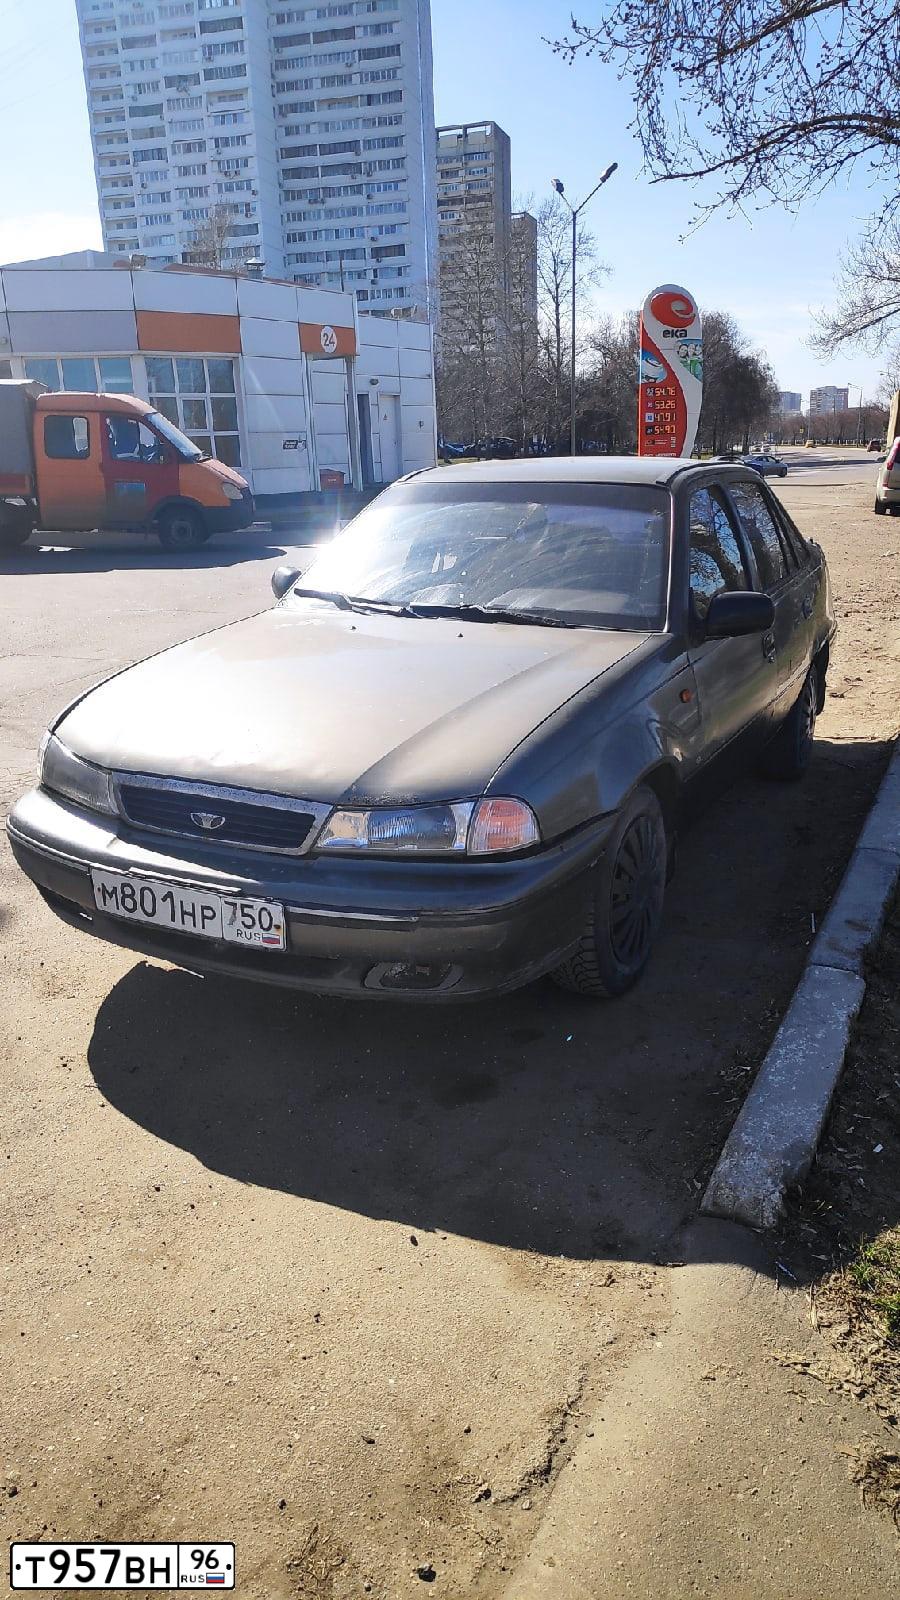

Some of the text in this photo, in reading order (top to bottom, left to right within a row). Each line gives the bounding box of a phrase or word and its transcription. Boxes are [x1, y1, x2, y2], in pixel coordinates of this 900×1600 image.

[322, 332, 336, 347] 24
[223, 900, 274, 932] 750
[236, 928, 261, 942] RUS
